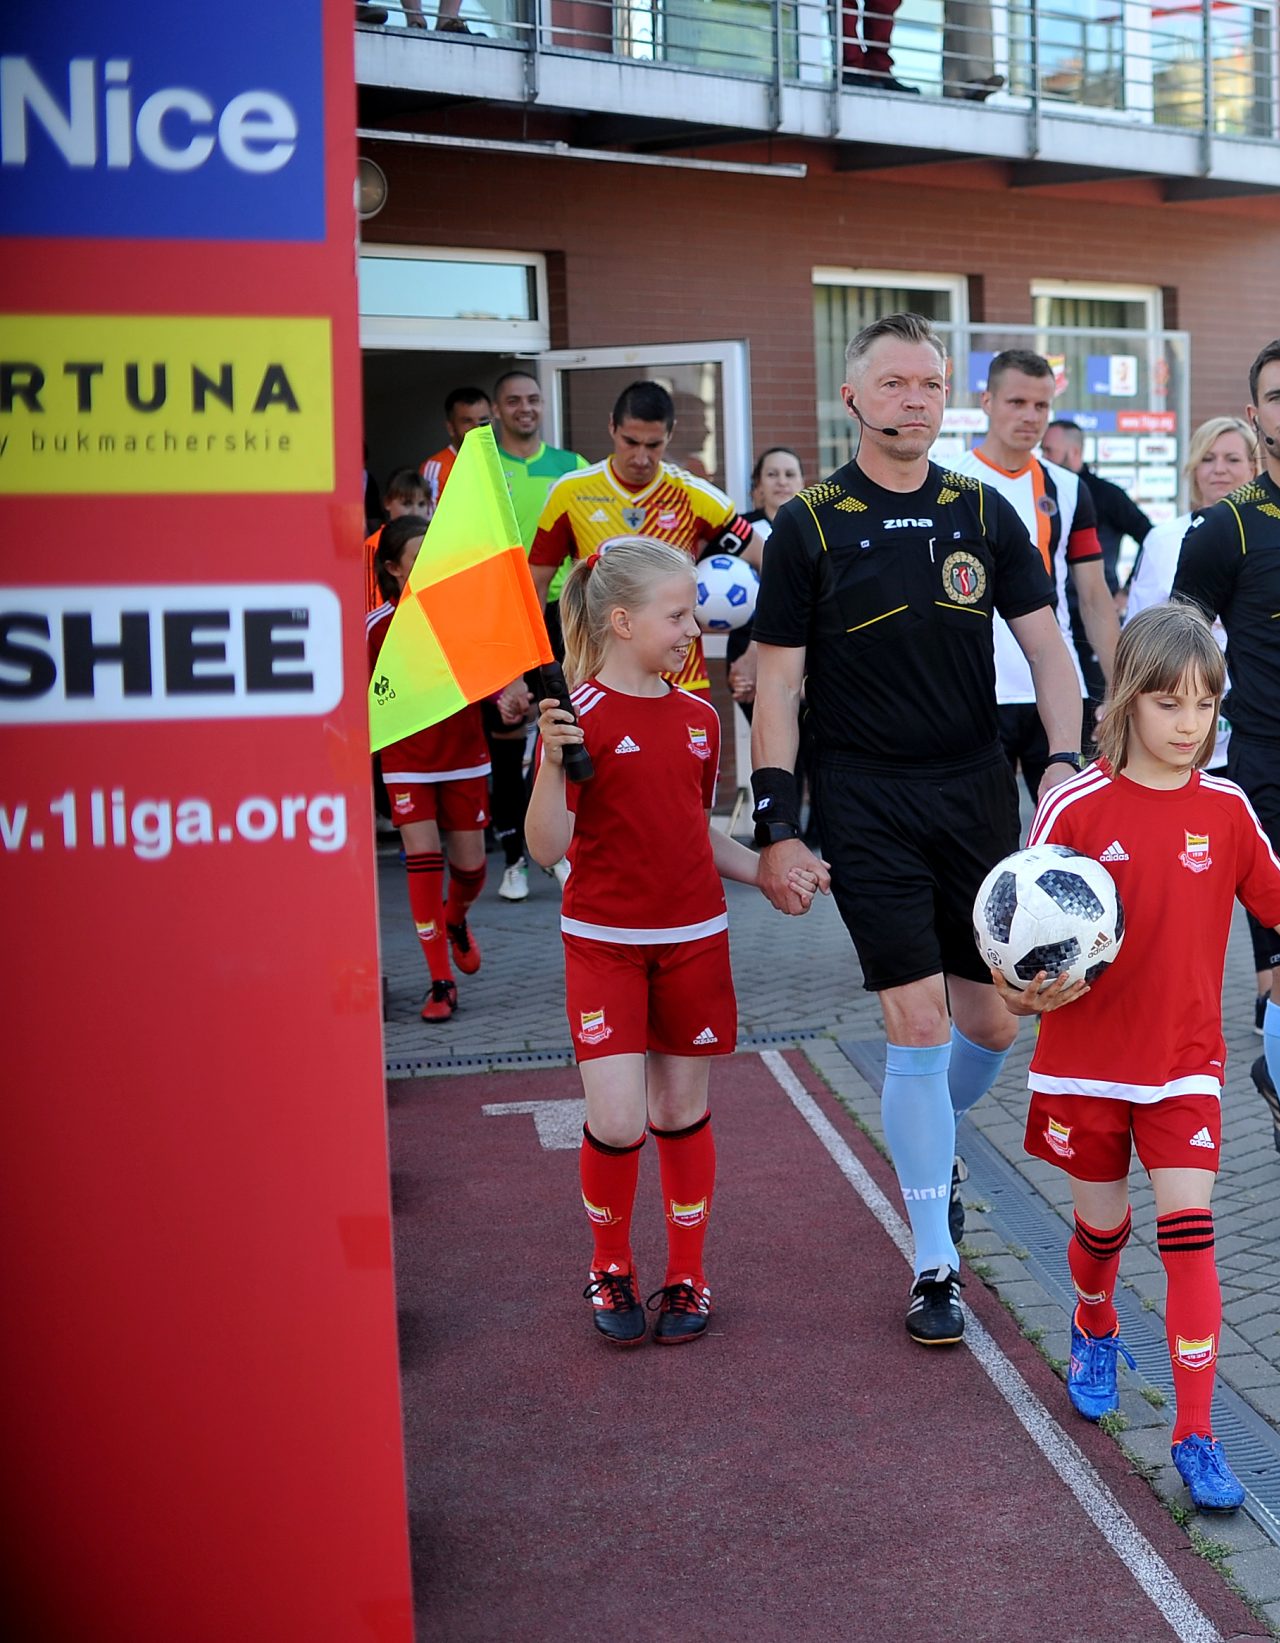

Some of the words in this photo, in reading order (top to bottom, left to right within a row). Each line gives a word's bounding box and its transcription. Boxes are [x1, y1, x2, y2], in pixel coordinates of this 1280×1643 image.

[0, 56, 298, 173] Nice
[31, 429, 292, 453] bukmacherskie
[883, 518, 933, 530] zina
[1100, 853, 1129, 862] adidas
[1087, 938, 1113, 959] adidas
